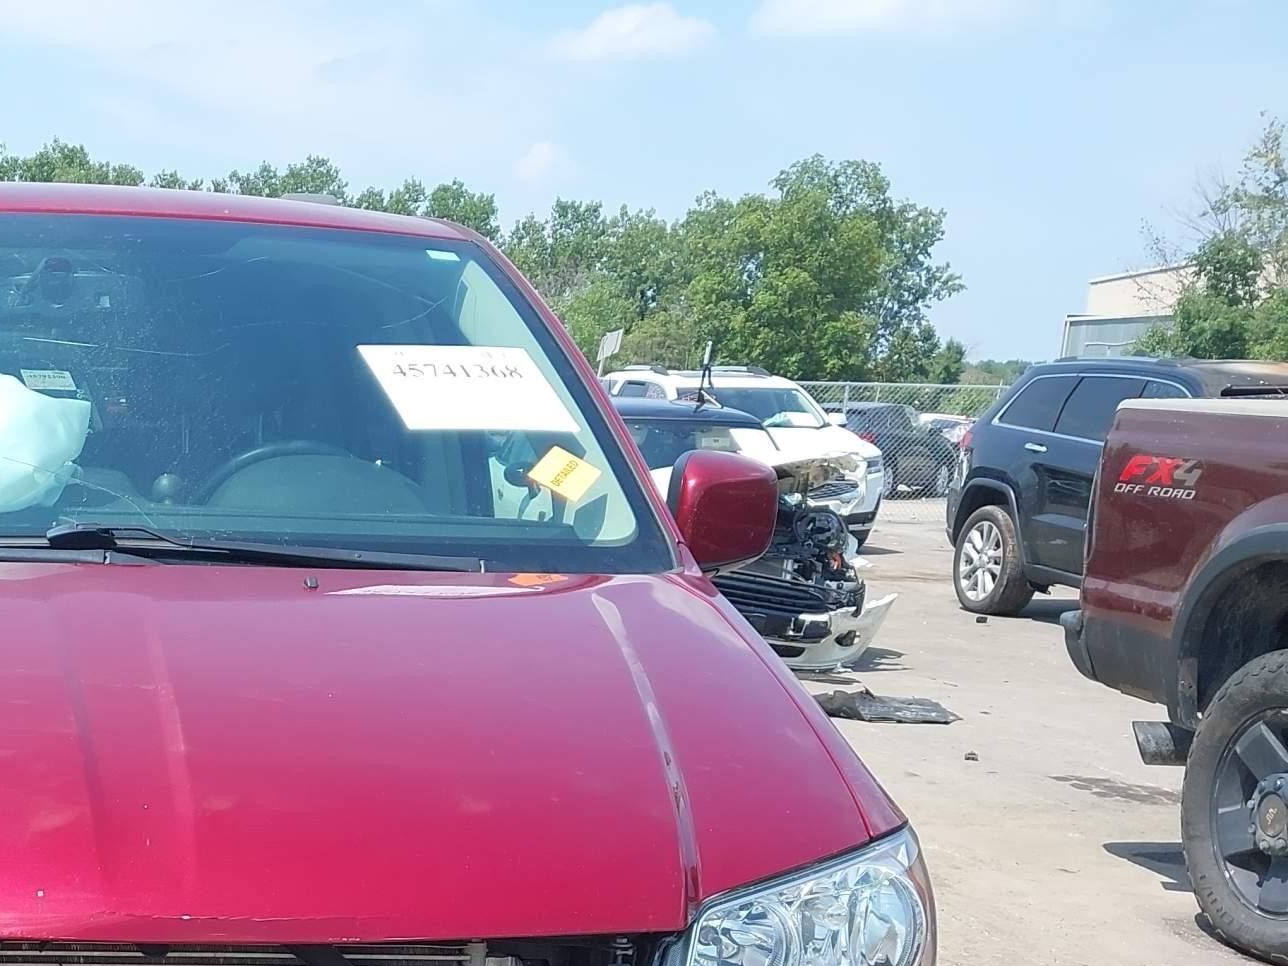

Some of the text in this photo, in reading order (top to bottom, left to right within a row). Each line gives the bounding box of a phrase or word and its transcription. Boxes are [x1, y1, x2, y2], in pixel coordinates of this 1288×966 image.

[392, 363, 524, 379] 45741368
[551, 459, 579, 488] DETAILED
[1119, 455, 1202, 486] FX4
[1114, 482, 1196, 500] OFF ROAD
